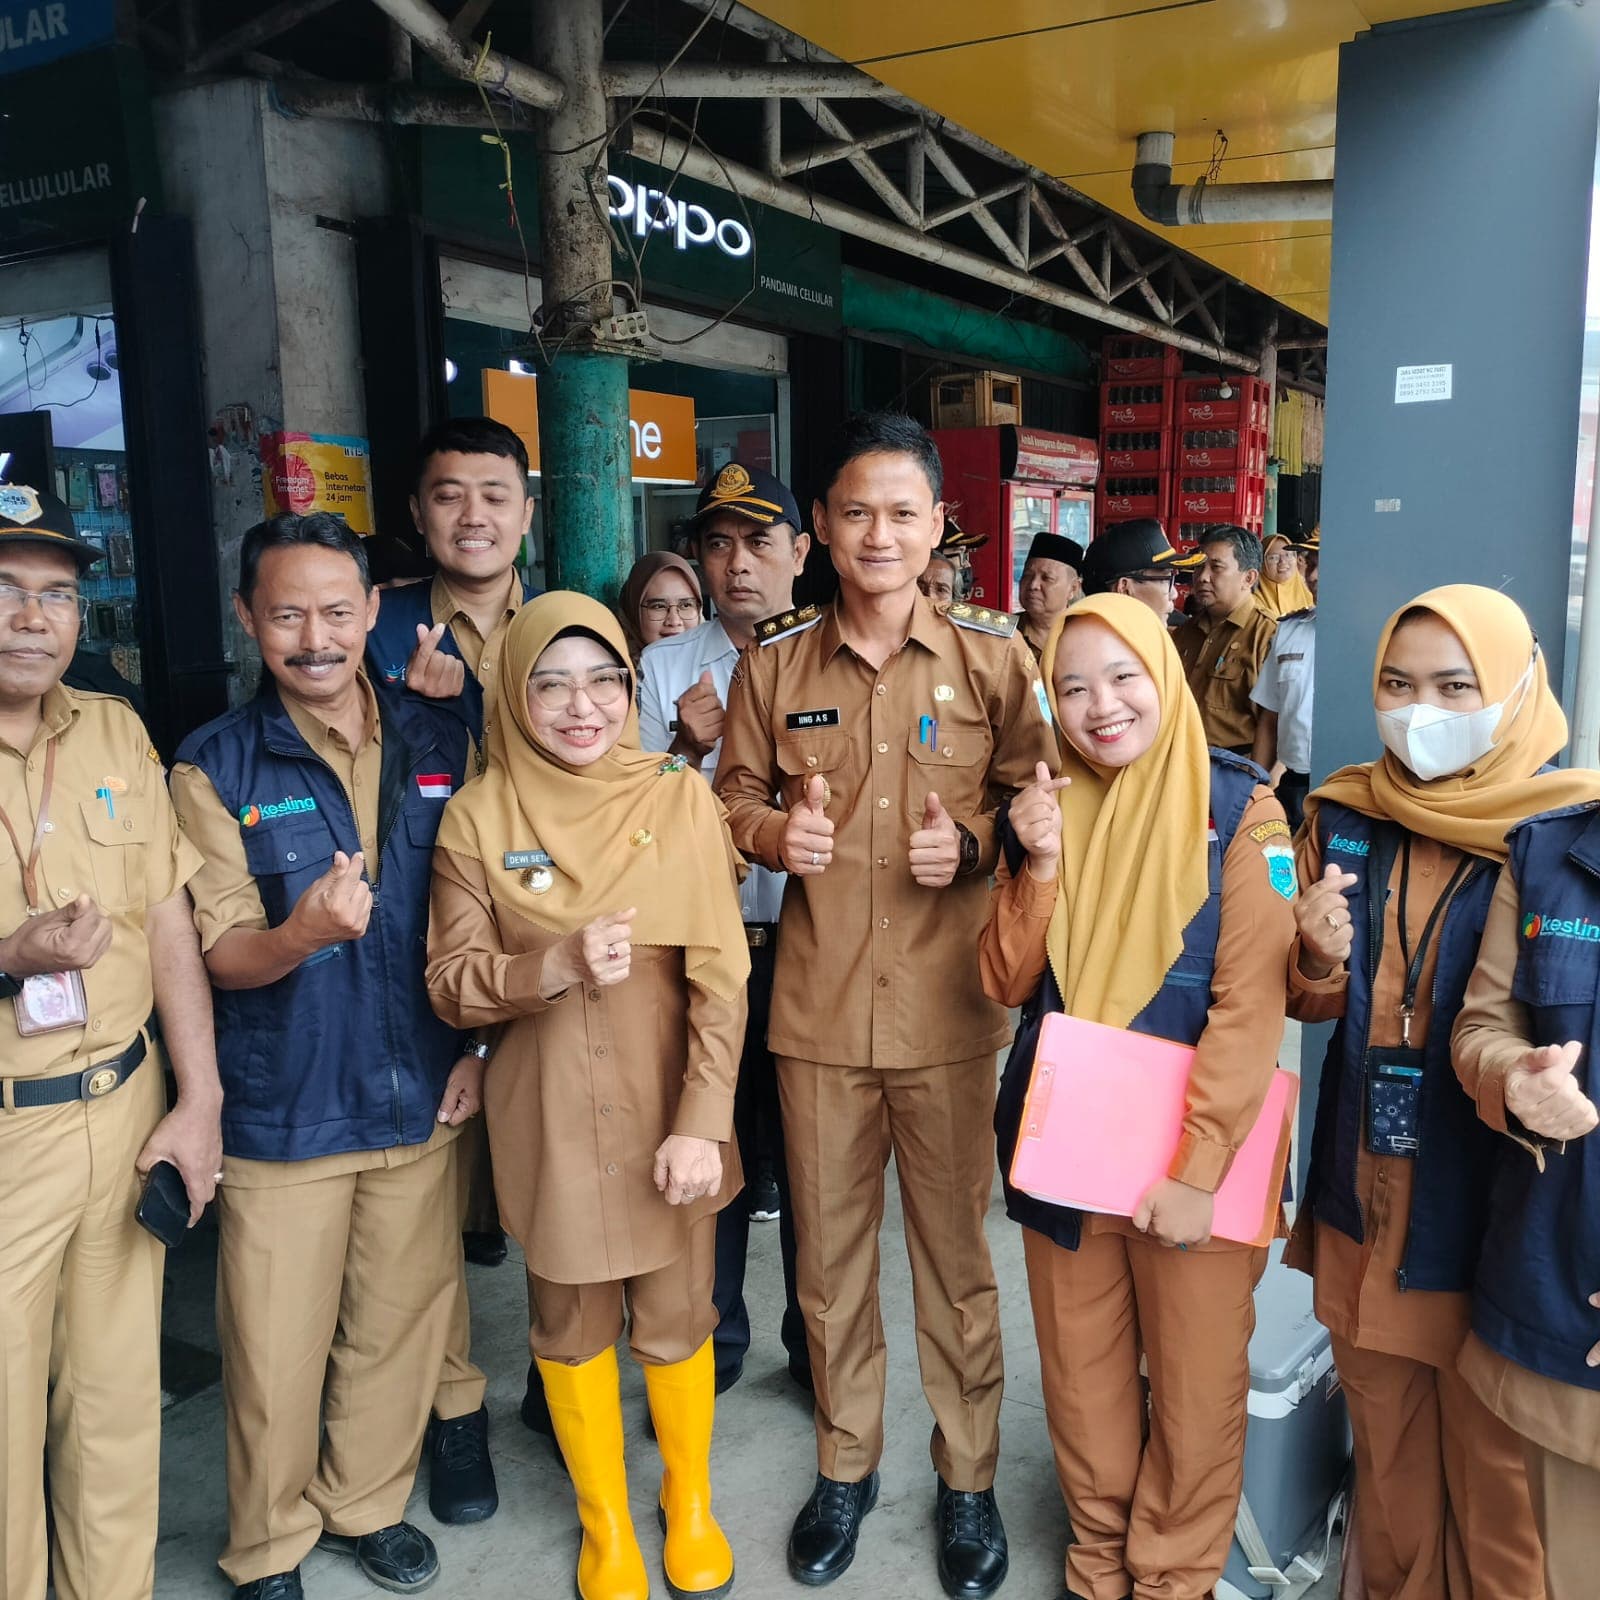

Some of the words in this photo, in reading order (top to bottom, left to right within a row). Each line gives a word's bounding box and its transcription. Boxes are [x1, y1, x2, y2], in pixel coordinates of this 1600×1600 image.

[608, 174, 751, 256] oppo
[760, 275, 798, 298] PANDAWA
[799, 287, 833, 307] CELLULAR
[324, 471, 349, 481] Bebas
[325, 482, 367, 493] Internetan
[326, 493, 336, 502] 24
[336, 493, 353, 505] jam
[815, 714, 822, 723] A
[822, 713, 828, 722] S
[258, 794, 316, 818] kesling
[509, 855, 529, 865] DEWI
